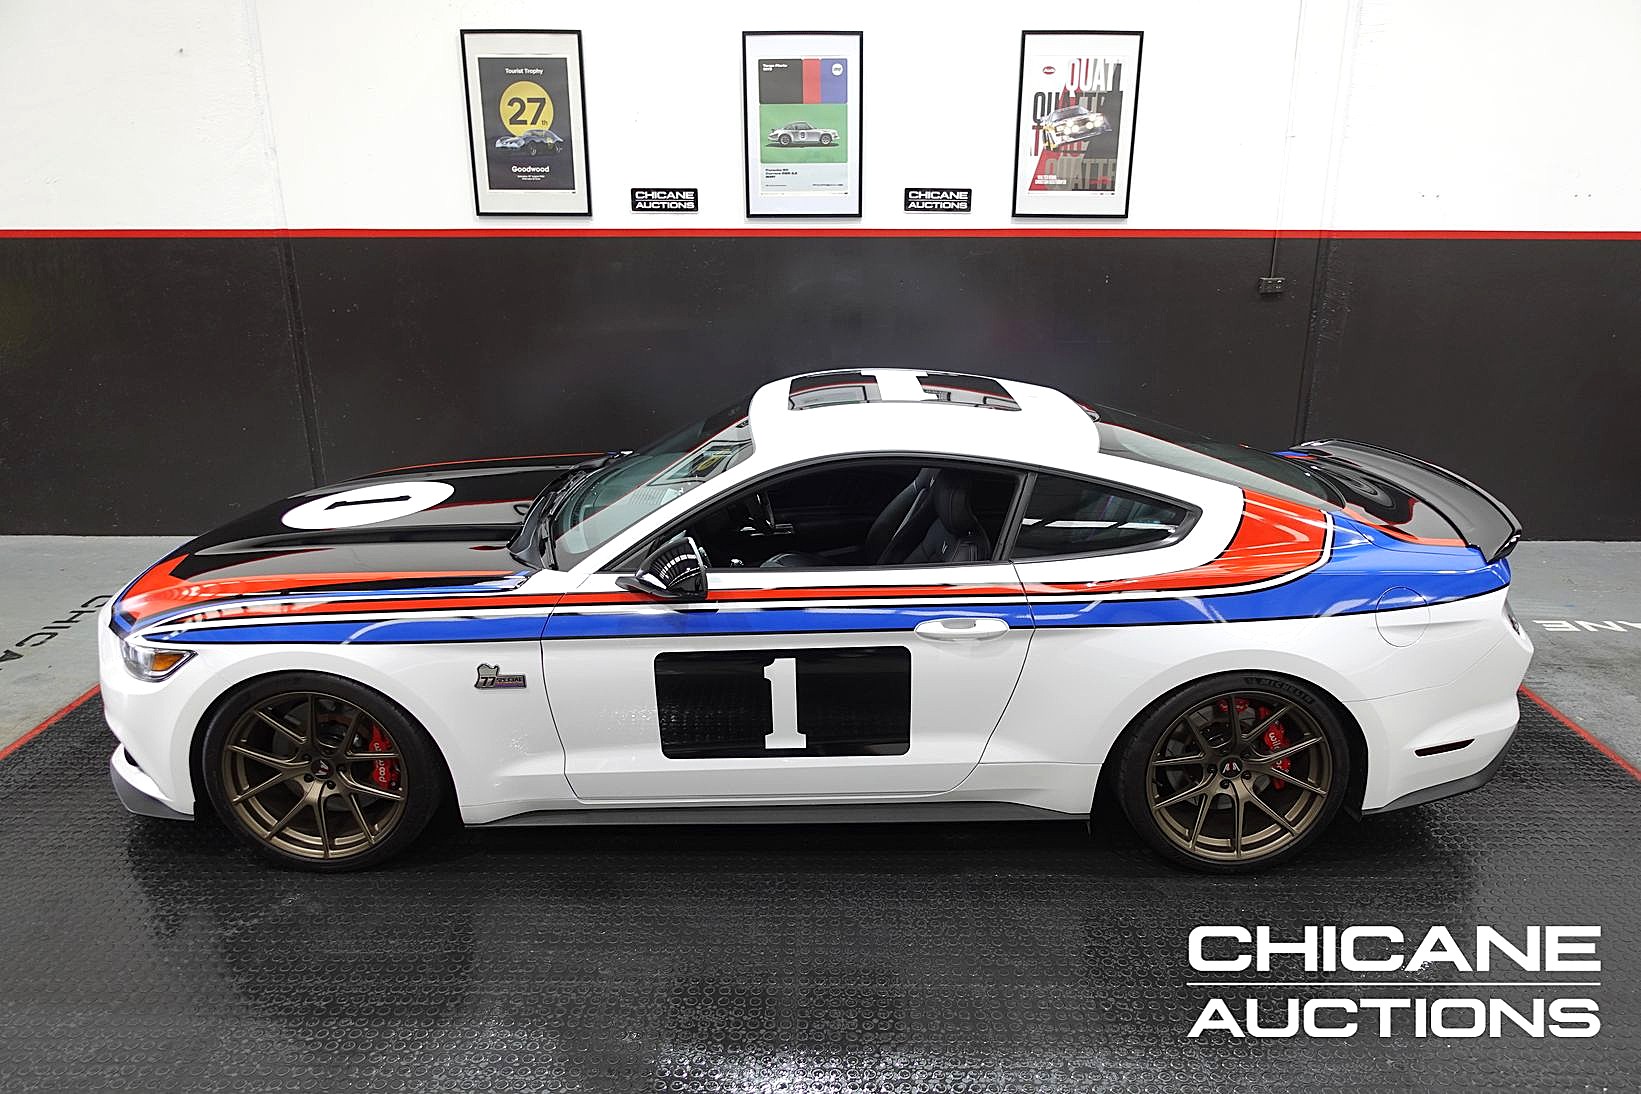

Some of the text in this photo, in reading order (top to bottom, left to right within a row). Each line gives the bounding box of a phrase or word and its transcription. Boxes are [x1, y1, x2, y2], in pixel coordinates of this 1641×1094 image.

[511, 165, 550, 173] Goodwood
[635, 191, 695, 199] CHICANE
[908, 191, 969, 199] CHICANE
[324, 495, 412, 510] 1
[480, 676, 497, 686] 77
[764, 658, 807, 749] 1
